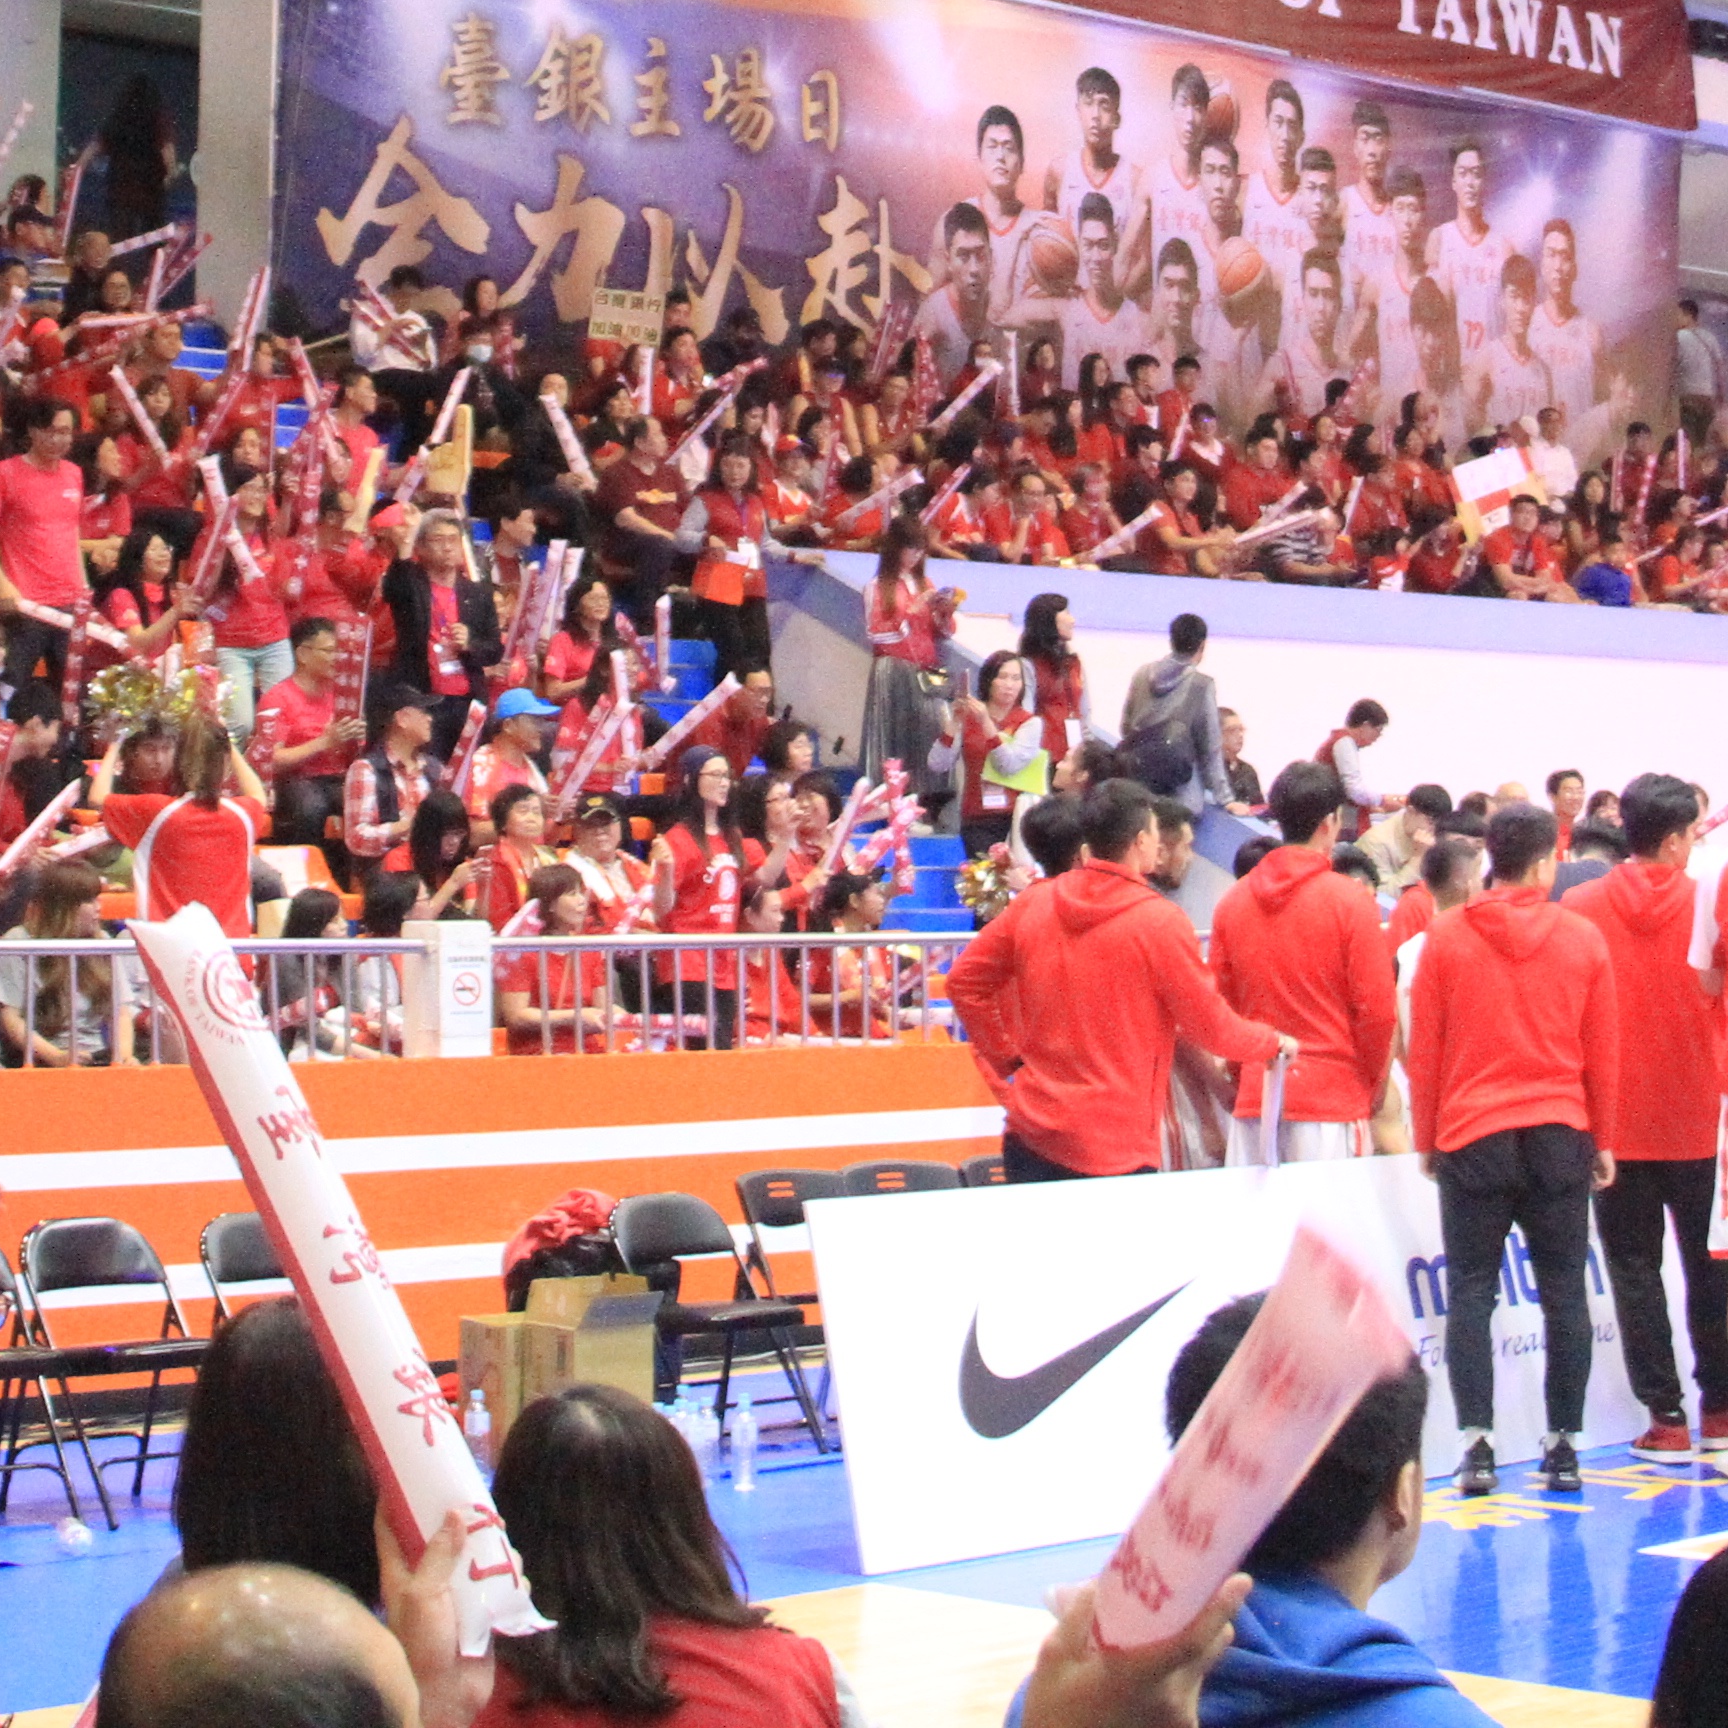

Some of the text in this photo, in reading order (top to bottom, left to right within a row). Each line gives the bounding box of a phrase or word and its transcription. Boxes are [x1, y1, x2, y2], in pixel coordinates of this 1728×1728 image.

[439, 10, 841, 154] 臺銀主場日
